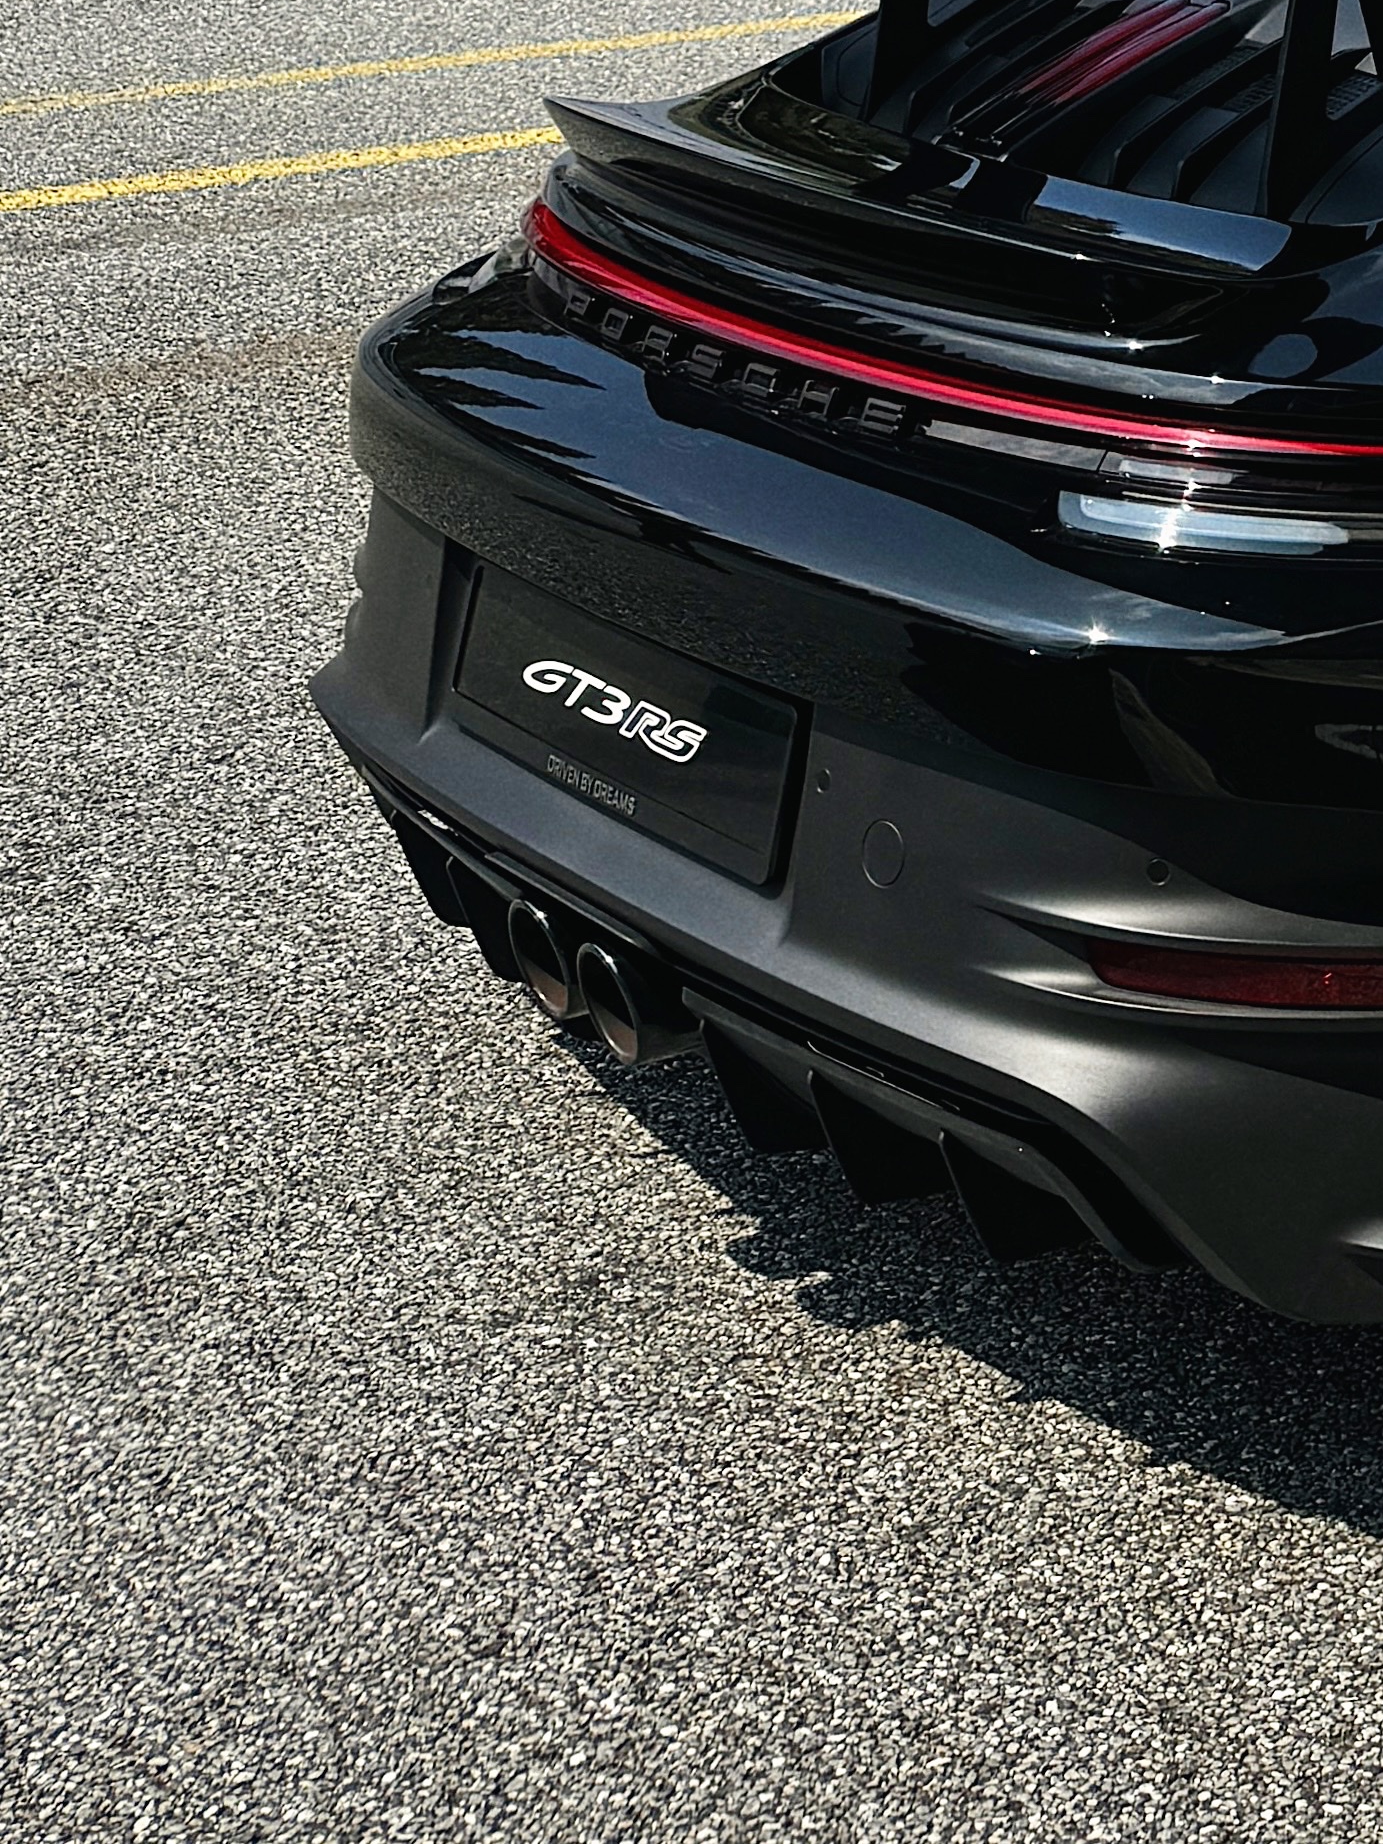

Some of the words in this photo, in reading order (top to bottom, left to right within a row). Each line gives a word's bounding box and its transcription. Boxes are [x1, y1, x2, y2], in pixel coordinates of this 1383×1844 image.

[564, 291, 907, 435] PORSCHE
[547, 754, 581, 791] DRIVEN
[580, 772, 595, 794] BY
